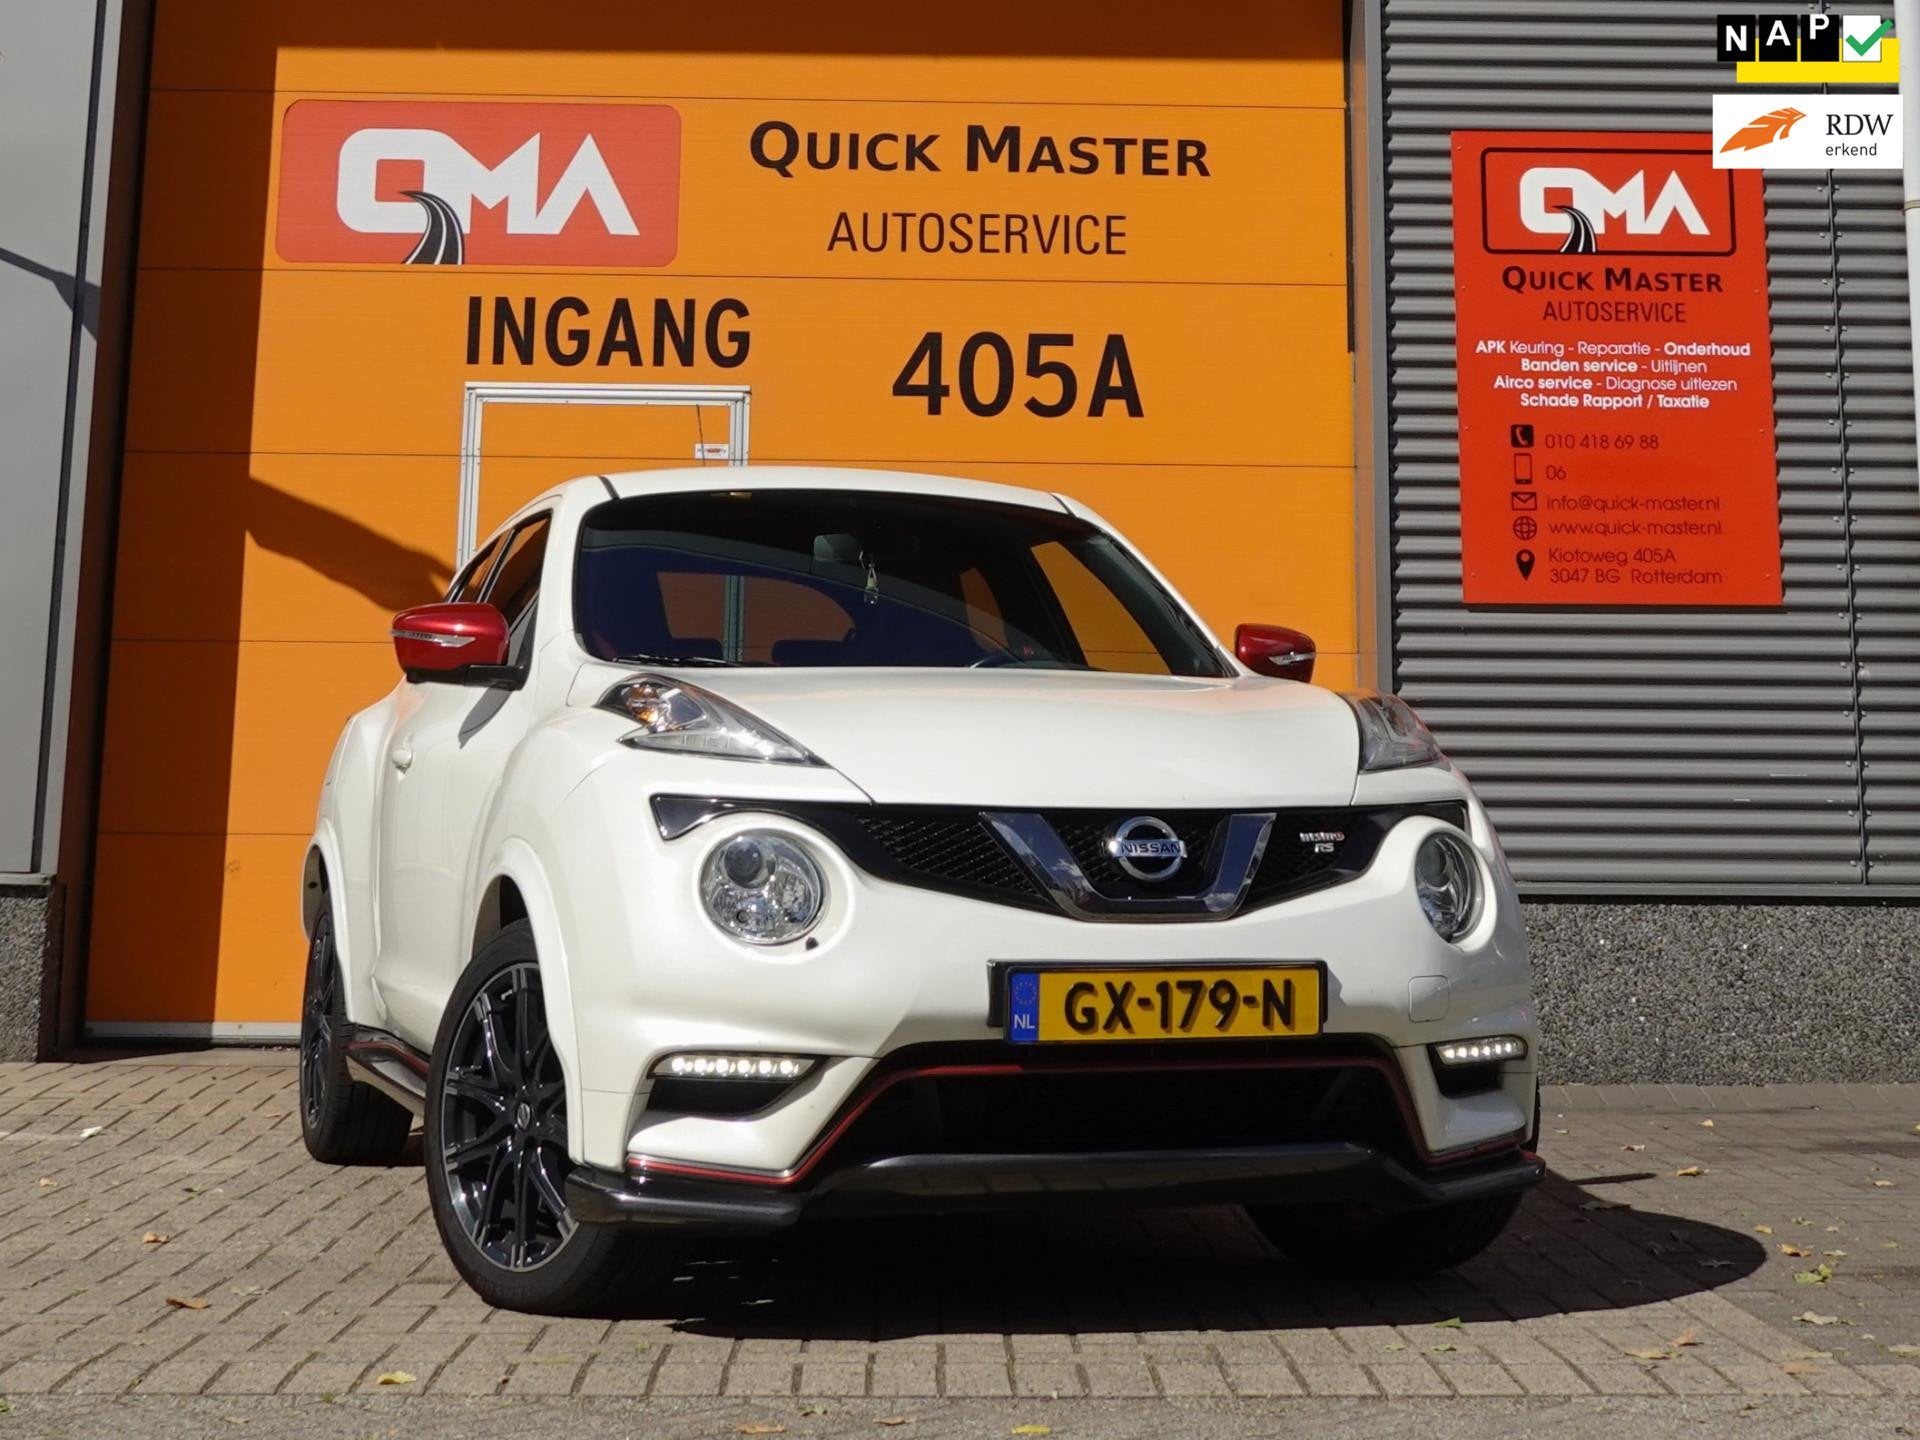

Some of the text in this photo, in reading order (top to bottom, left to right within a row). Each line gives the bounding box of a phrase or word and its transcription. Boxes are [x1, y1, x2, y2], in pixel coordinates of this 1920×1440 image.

[336, 128, 640, 250] QMA
[1520, 167, 1711, 244] QMA
[827, 212, 1127, 255] AUTOSERVICE
[1542, 301, 1687, 323] AUTOSERVICE
[465, 295, 751, 368] INGANG
[1476, 341, 1506, 354] APK
[1510, 342, 1564, 357] Keuring
[1578, 341, 1651, 357] Reparatie
[1664, 342, 1751, 356] Onderhoud
[892, 331, 1144, 418] 405A
[1521, 359, 1579, 372] Banden
[1583, 359, 1638, 372] service
[1651, 359, 1707, 375] Uitlijnen
[1494, 376, 1534, 389] Airco
[1538, 376, 1593, 390] service
[1606, 376, 1676, 393] Diagnose
[1681, 377, 1737, 391] uitlezen
[1520, 393, 1578, 407] Schade
[1583, 394, 1642, 410] Rapport
[1657, 395, 1710, 408] Taxatie
[1545, 434, 1659, 450] 010 418 69 88
[1545, 466, 1567, 480] 06
[1546, 495, 1720, 513] info@quick-master.nl
[1548, 519, 1722, 537] www.quick-master.nl
[1633, 548, 1676, 564] 405A
[1549, 568, 1722, 584] 3047 BG Rotterdam
[1121, 843, 1181, 854] NISSAN
[1014, 979, 1294, 1033] NL GX-179-N
